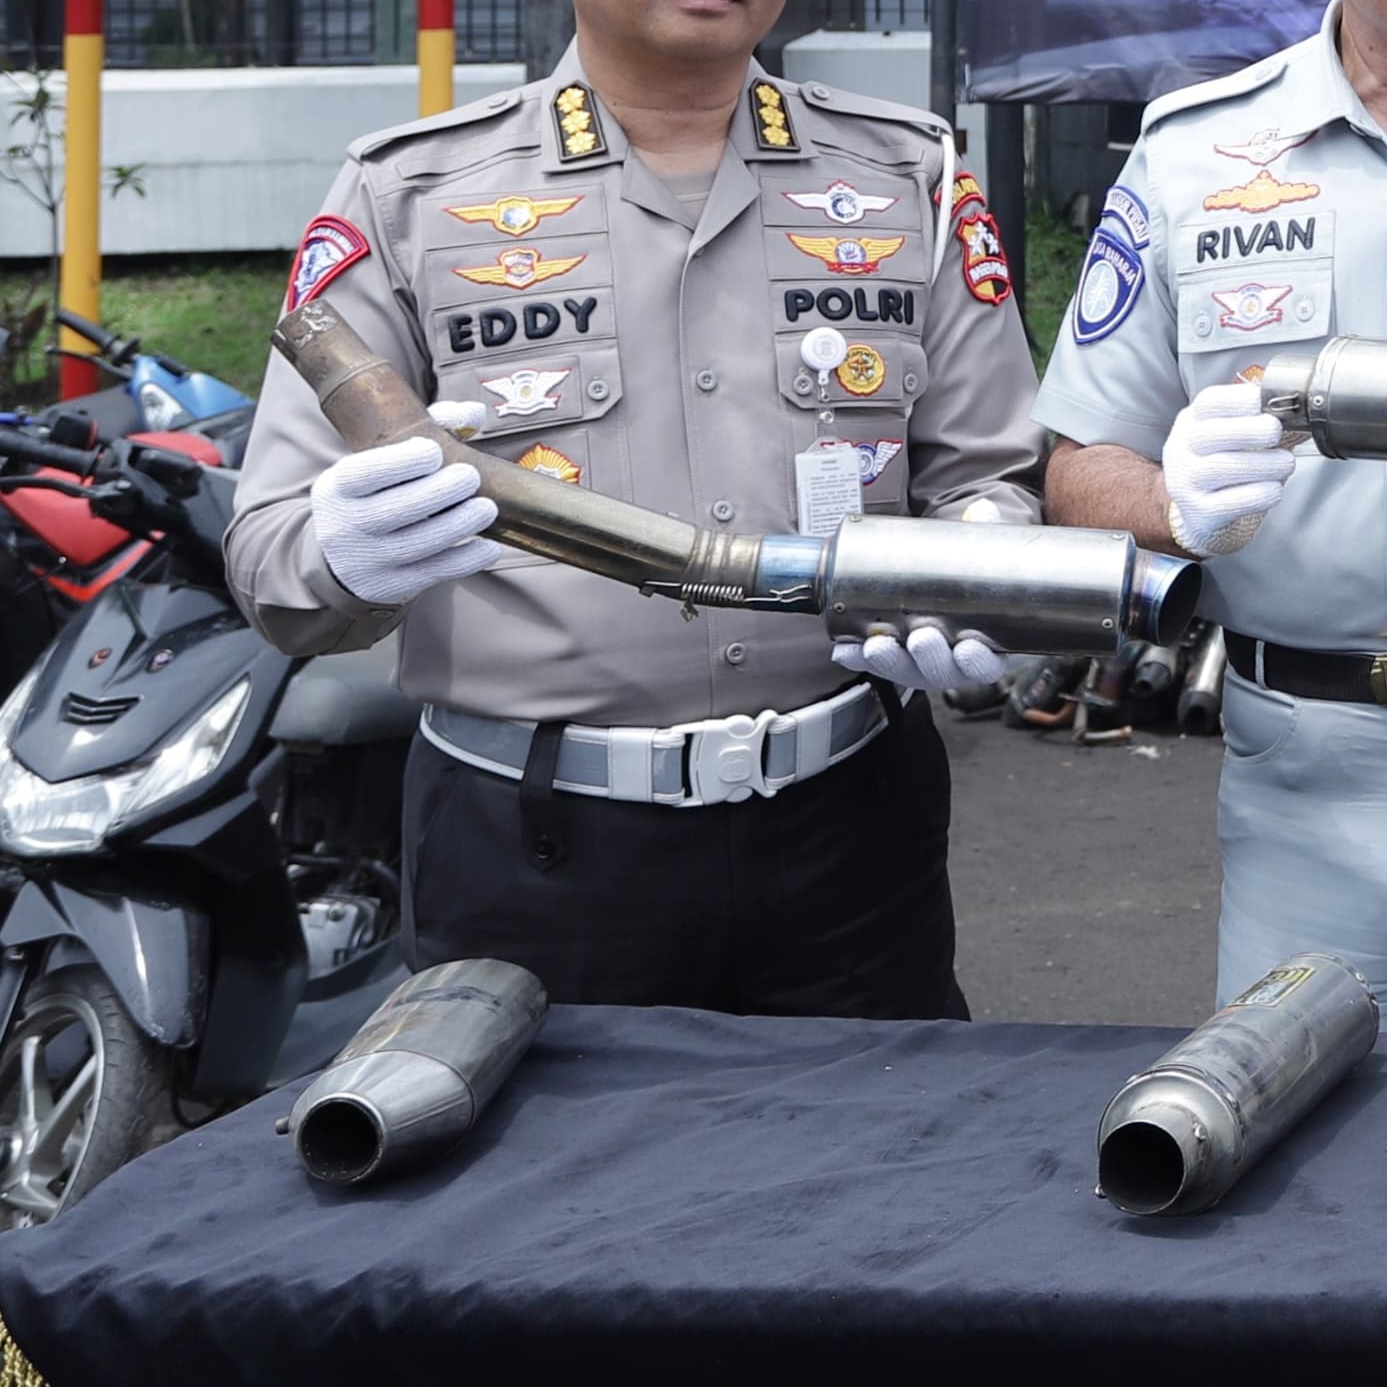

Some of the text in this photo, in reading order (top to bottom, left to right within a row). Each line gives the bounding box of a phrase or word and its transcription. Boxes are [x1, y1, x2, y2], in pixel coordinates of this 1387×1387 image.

[1197, 217, 1317, 264] RIVAN
[449, 297, 597, 354] EDDY
[784, 287, 914, 326] POLRI
